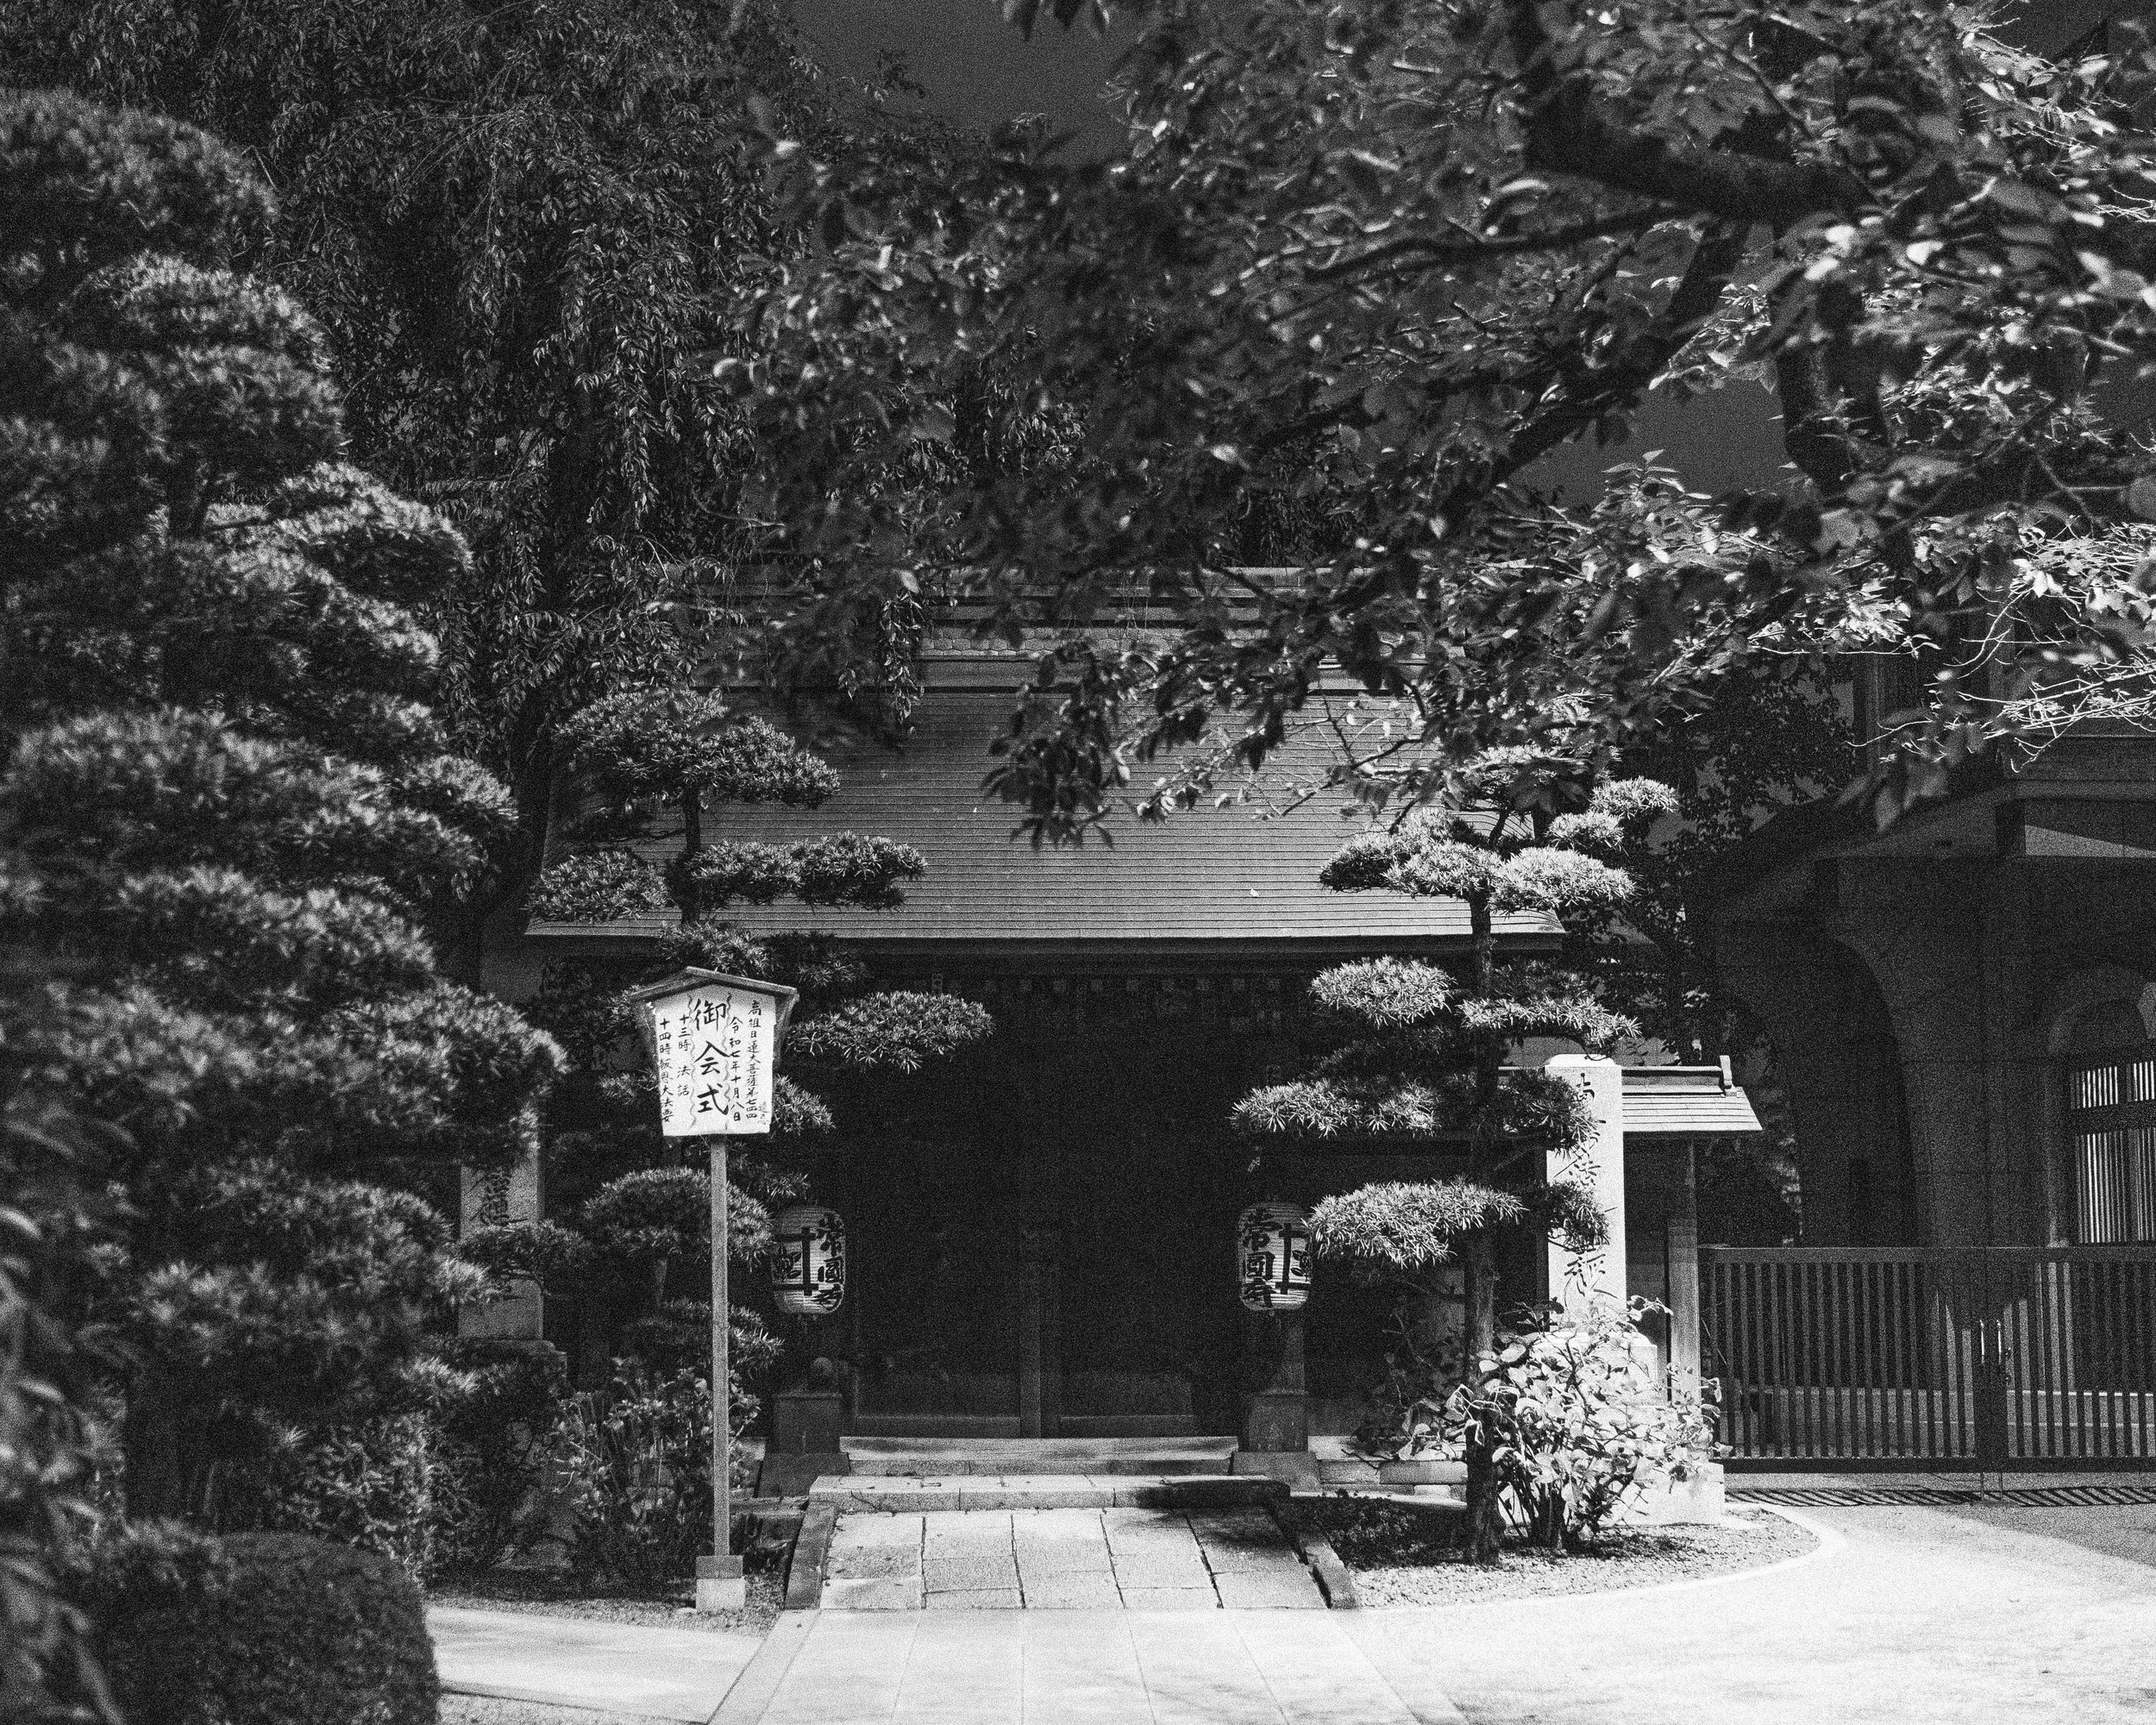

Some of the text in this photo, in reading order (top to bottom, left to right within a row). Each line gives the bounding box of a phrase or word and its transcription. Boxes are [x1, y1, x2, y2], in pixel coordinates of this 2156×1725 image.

[693, 998, 730, 1115] 御会式
[729, 1016, 744, 1121] 令和七年十月八日
